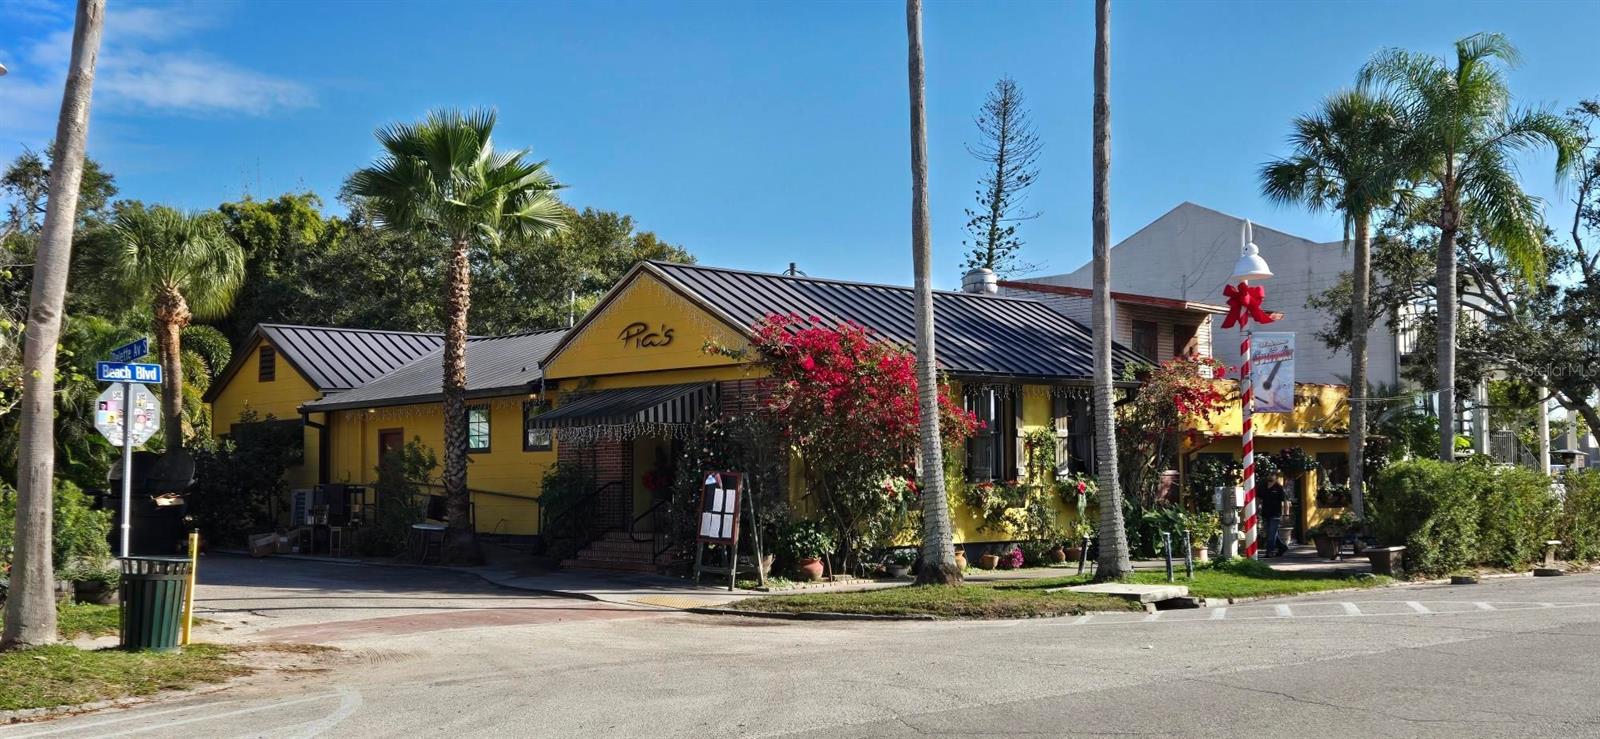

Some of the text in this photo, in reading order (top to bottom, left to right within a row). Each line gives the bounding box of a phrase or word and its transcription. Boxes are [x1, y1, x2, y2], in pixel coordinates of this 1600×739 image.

[617, 322, 675, 349] Pia's
[102, 364, 156, 380] Beach Blvd
